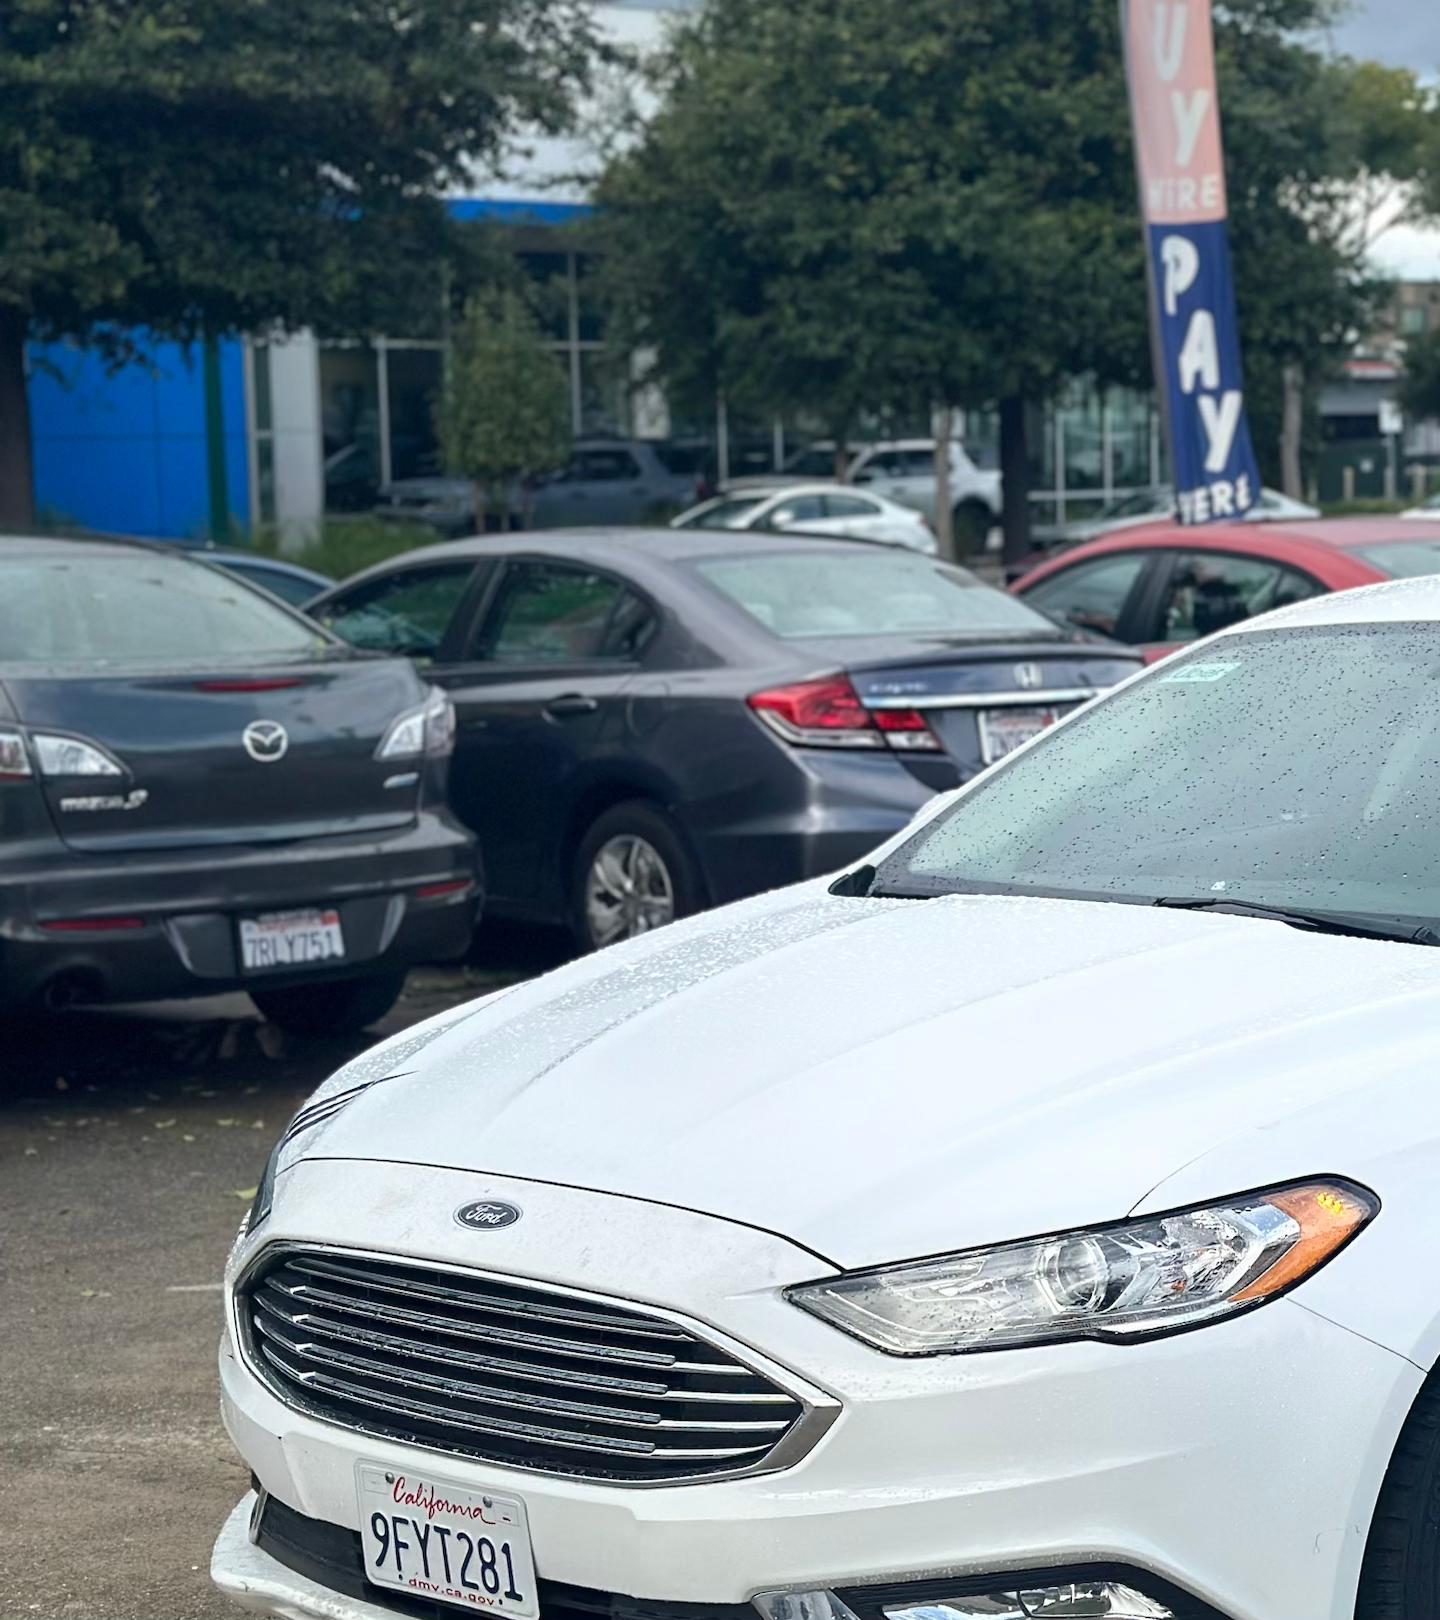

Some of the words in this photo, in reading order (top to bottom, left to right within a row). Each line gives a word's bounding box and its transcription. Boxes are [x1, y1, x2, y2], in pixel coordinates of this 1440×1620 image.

[1160, 234, 1243, 473] PAY
[246, 930, 336, 968] 7RLY751
[465, 1203, 508, 1225] Ford
[392, 1476, 496, 1525] California
[370, 1511, 524, 1603] 9FYT281
[408, 1577, 496, 1607] dmv.ca.gov
